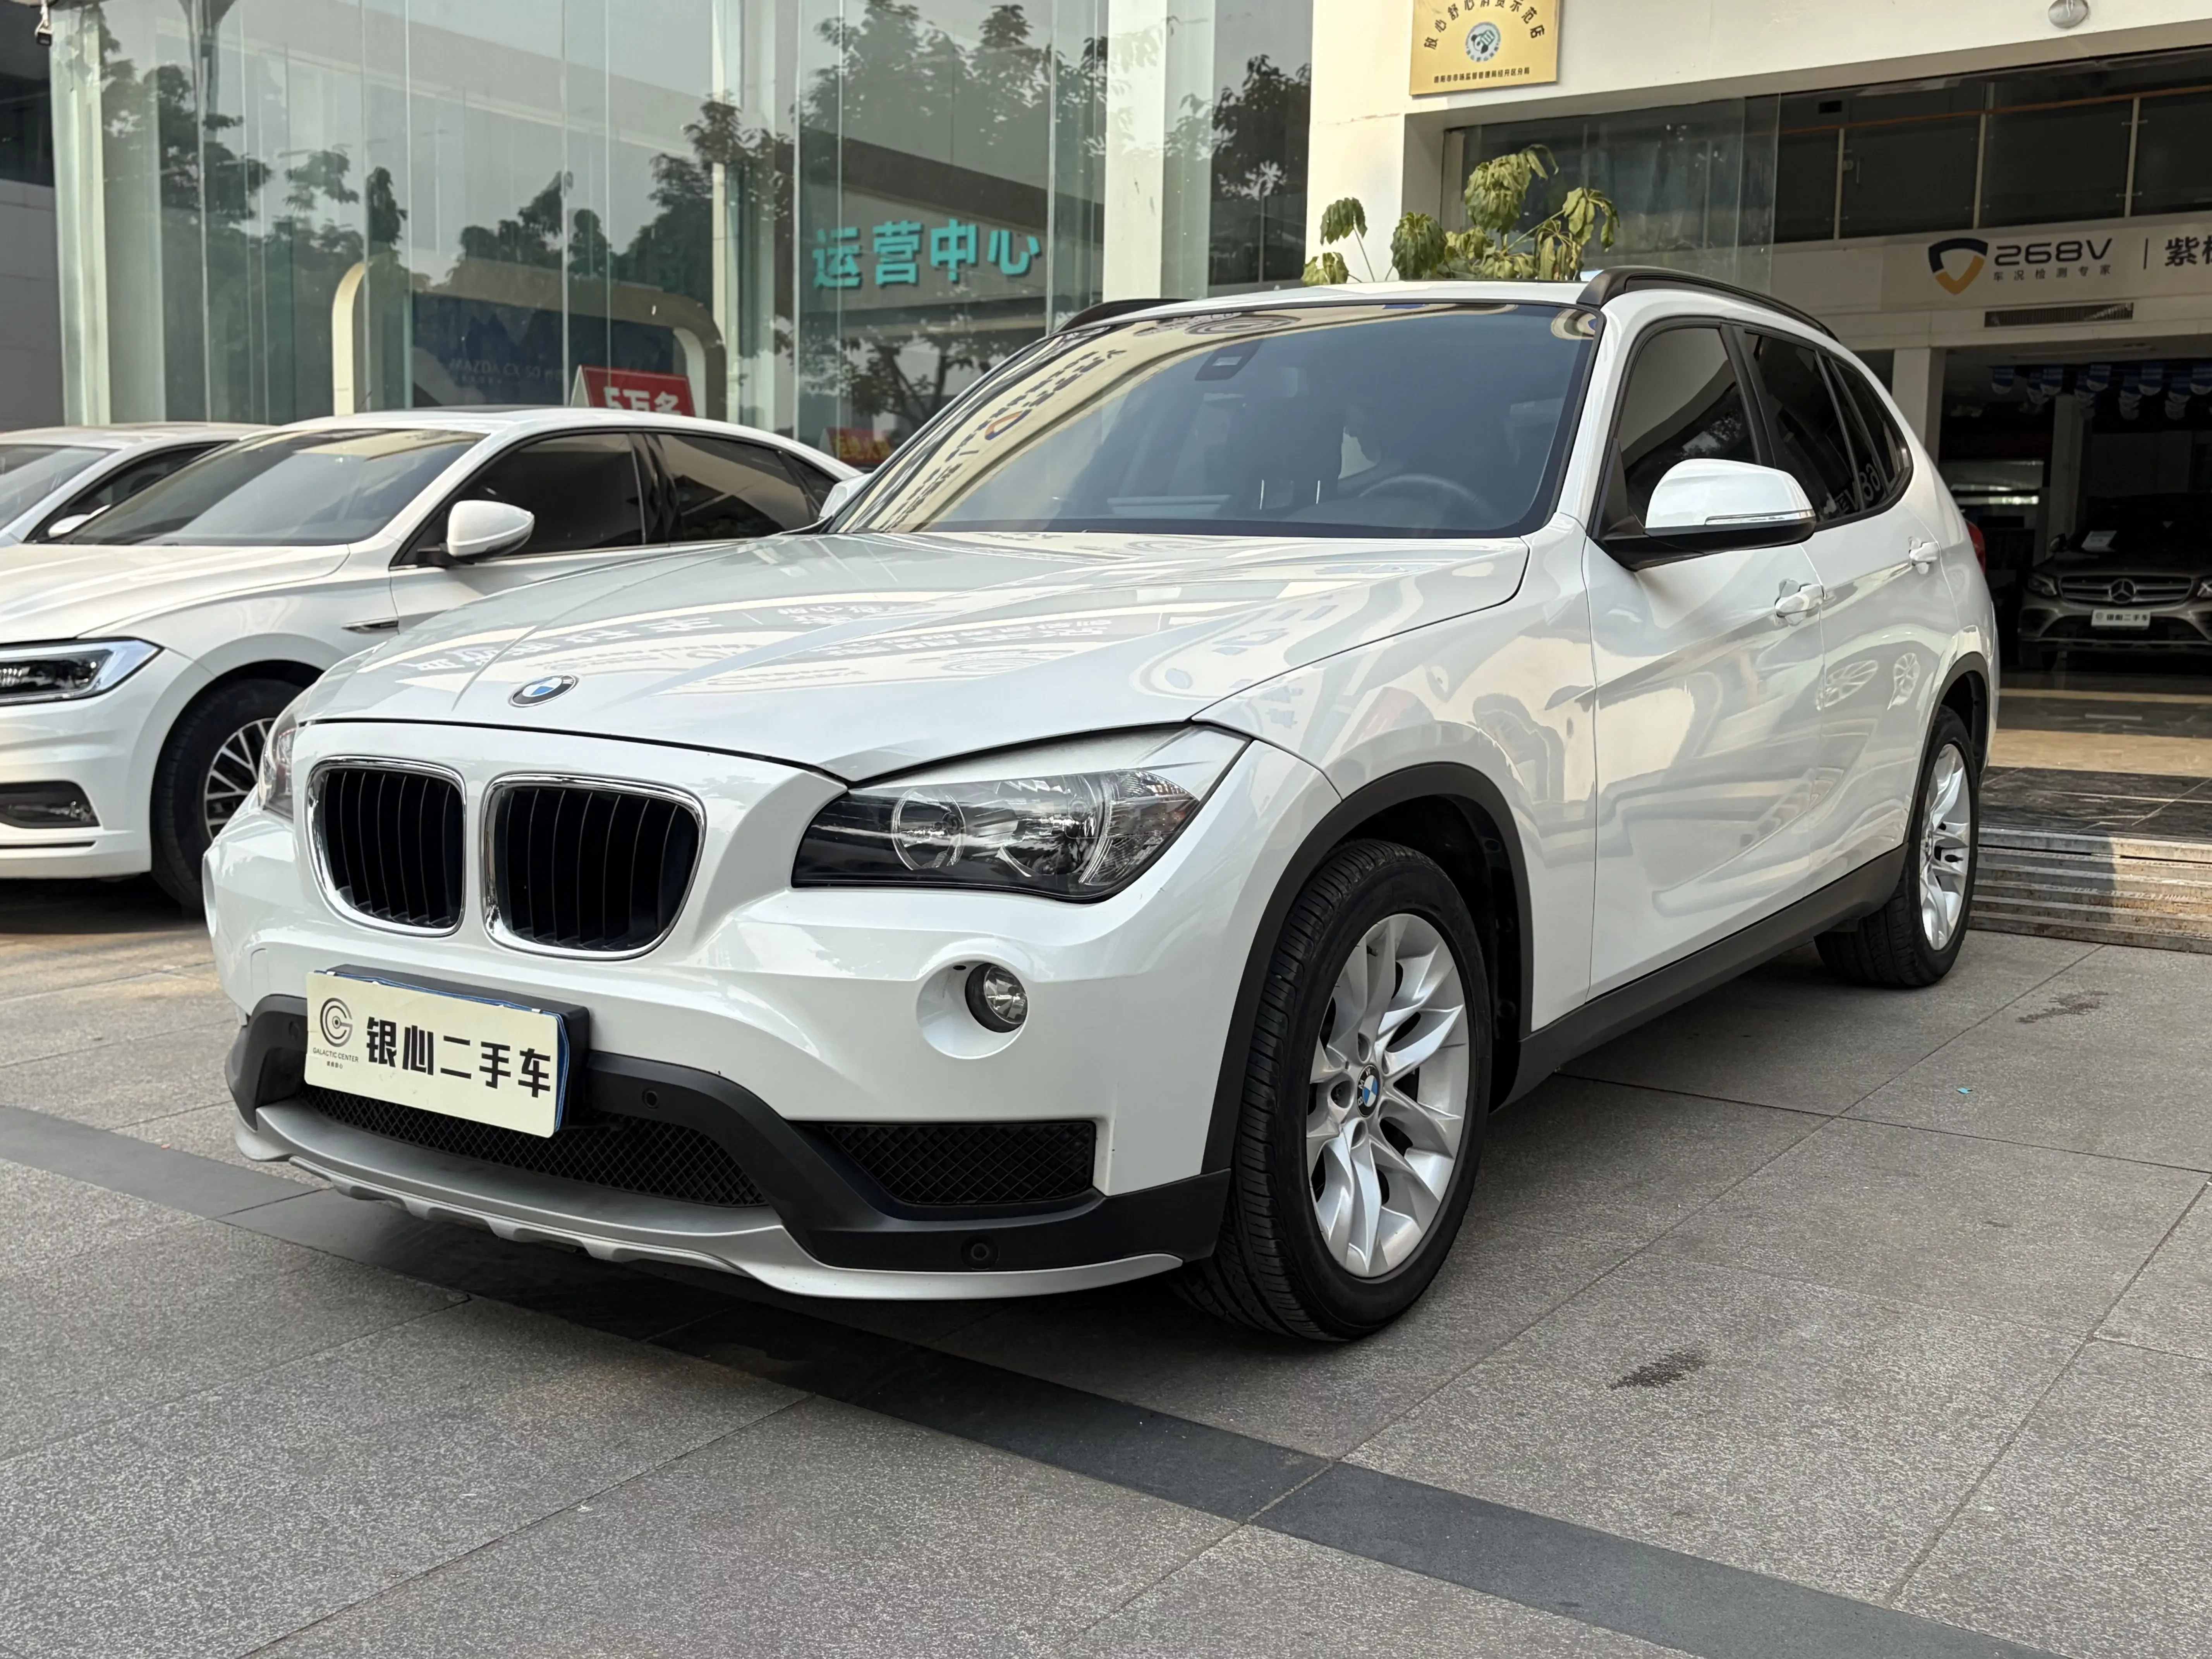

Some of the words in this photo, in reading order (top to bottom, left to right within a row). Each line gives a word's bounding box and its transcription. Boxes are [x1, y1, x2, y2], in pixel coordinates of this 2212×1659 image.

[812, 218, 1042, 288] 运营中心
[1994, 238, 2113, 266] 268V
[1994, 264, 2111, 282] 车况检测专家
[313, 1047, 337, 1058] GALACTIC
[338, 1052, 359, 1063] CENTER
[366, 1016, 551, 1099] 银心二手车
[1358, 1067, 1371, 1106] BMW
